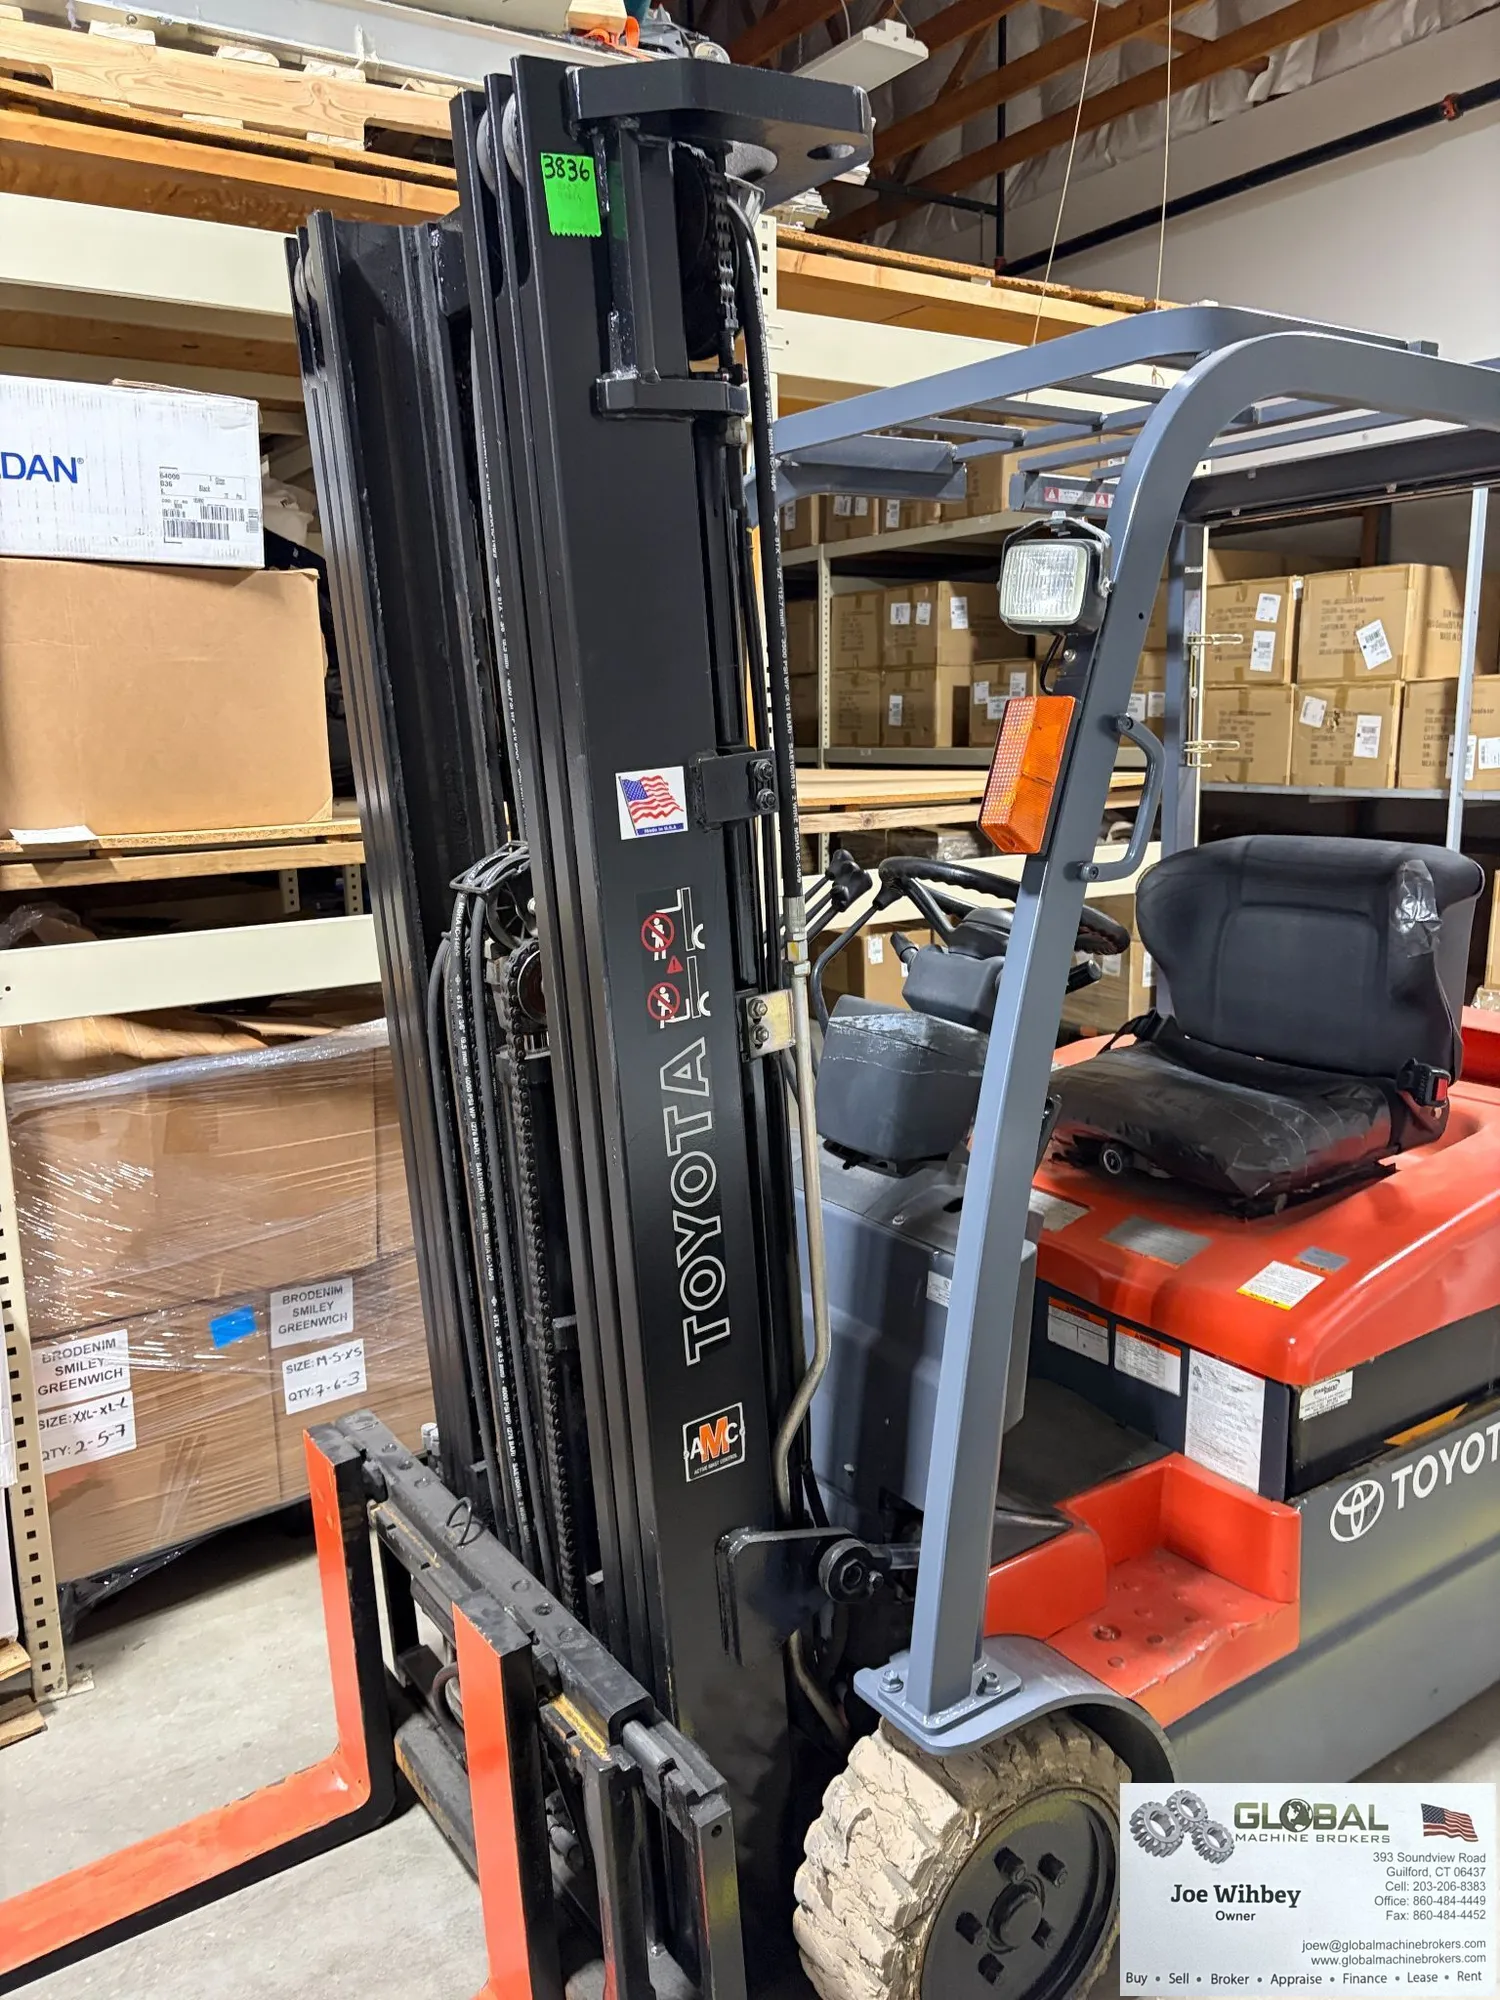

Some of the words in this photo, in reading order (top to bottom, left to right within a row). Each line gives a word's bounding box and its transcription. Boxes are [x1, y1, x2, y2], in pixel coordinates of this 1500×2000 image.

[543, 155, 590, 182] 3836
[784, 676, 790, 690] WP
[455, 902, 464, 925] MSHA
[469, 1107, 476, 1118] WP
[475, 1163, 486, 1201] SAE100R16
[481, 1212, 489, 1230] WIRE
[660, 1037, 731, 1366] TOYOTA
[282, 1286, 343, 1305] BRODENIM
[292, 1301, 334, 1318] SMILEY
[278, 1313, 348, 1335] GREENWICH
[42, 1338, 117, 1364] BRODENIM
[54, 1357, 104, 1377] SMILEY
[286, 1359, 314, 1375] SIZE:
[38, 1367, 123, 1396] GREENWICH
[288, 1387, 314, 1402] QTY:
[39, 1413, 72, 1431] SIZE:
[690, 1416, 738, 1463] AMC
